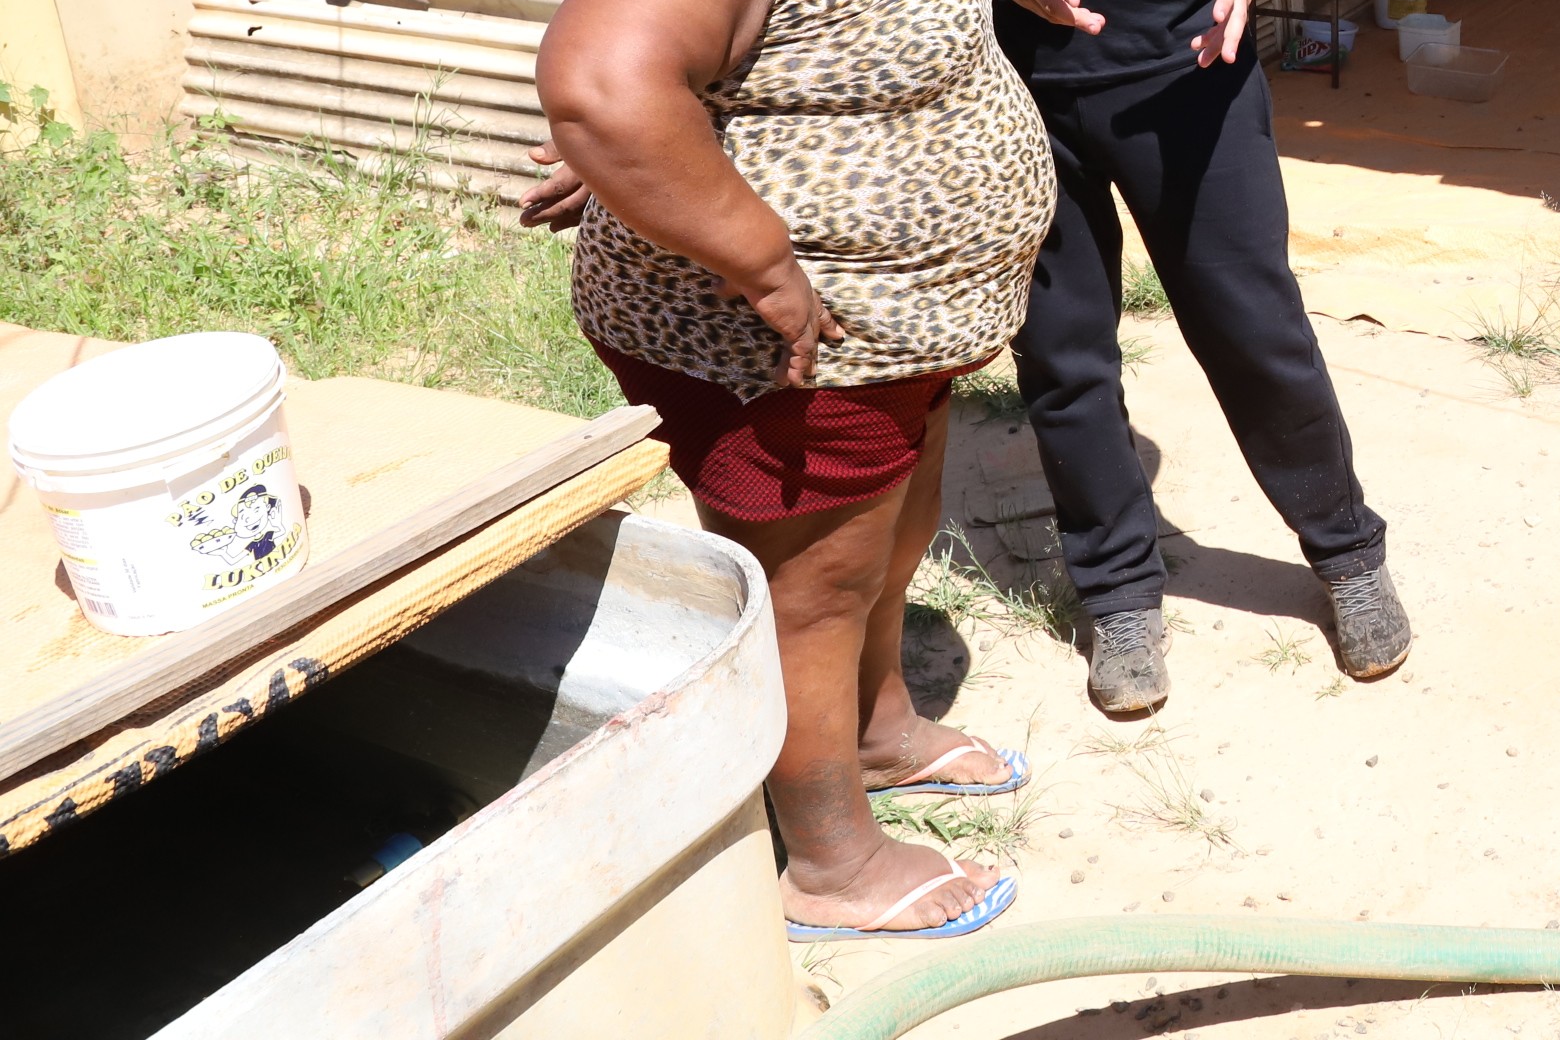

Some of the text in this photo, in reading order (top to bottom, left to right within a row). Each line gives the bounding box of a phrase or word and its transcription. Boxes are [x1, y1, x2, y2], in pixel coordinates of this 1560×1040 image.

[219, 468, 249, 494] DE
[202, 522, 303, 591] LUKINHA
[202, 584, 254, 608] MASSA PRONTA
